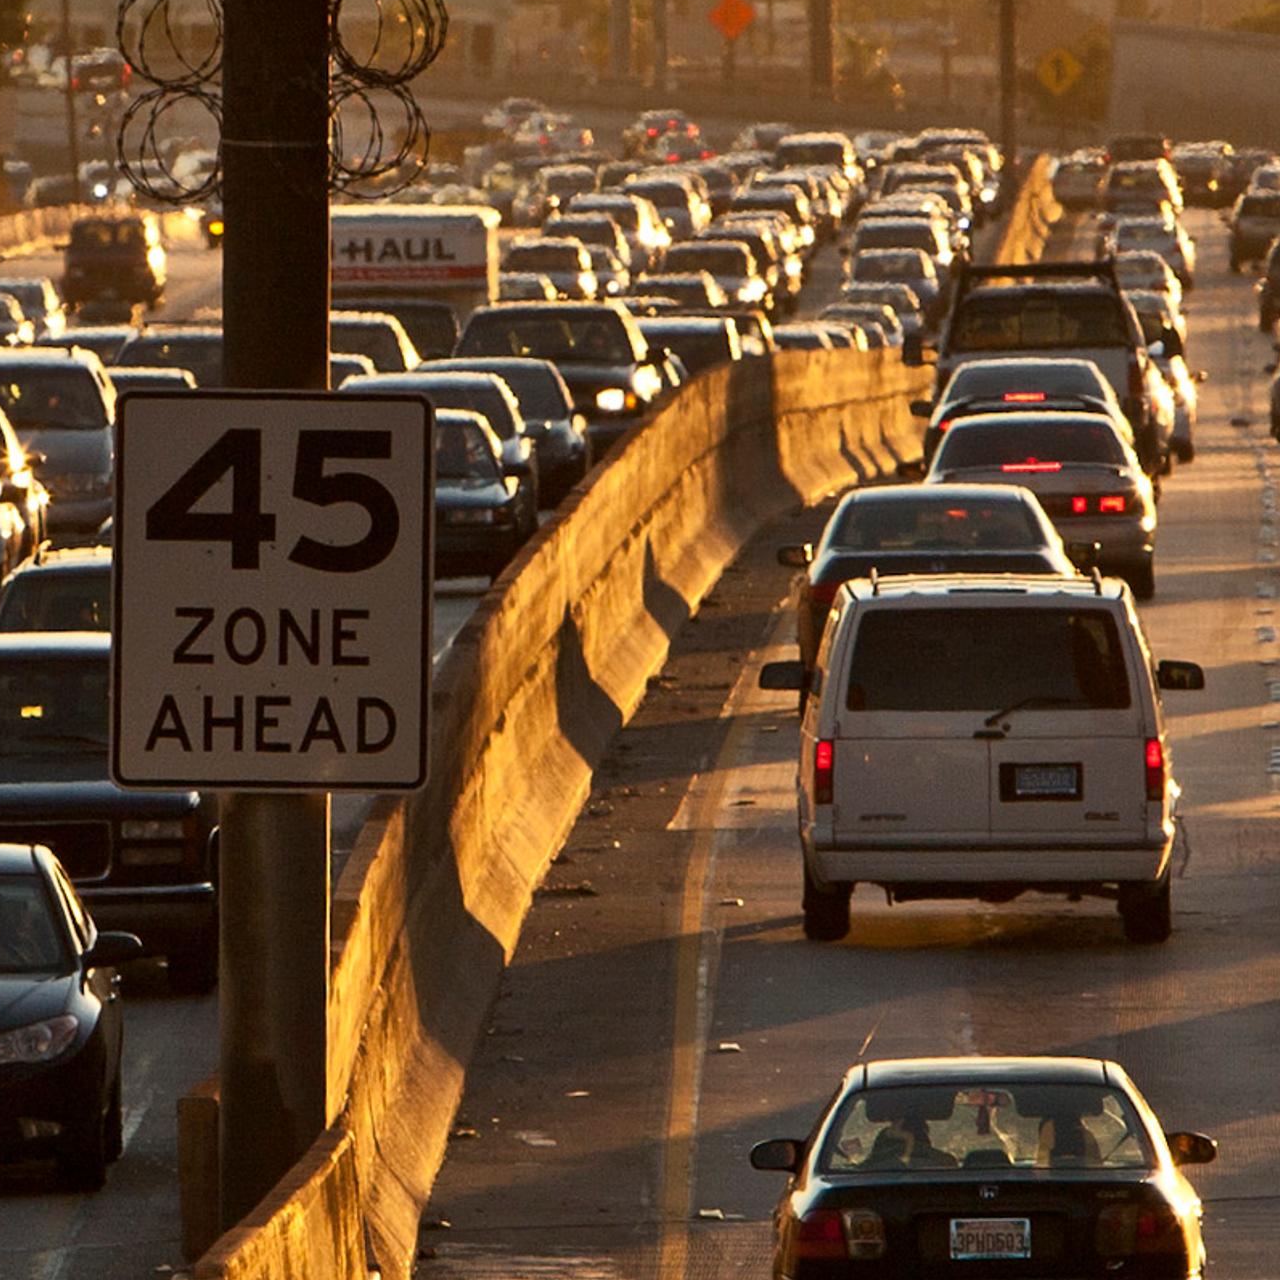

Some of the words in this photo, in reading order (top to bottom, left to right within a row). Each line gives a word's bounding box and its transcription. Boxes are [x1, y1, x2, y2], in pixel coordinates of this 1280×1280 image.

[331, 237, 456, 263] -HAUL
[145, 427, 400, 573] 45
[173, 606, 370, 666] ZONE
[144, 694, 397, 755] AHEAD
